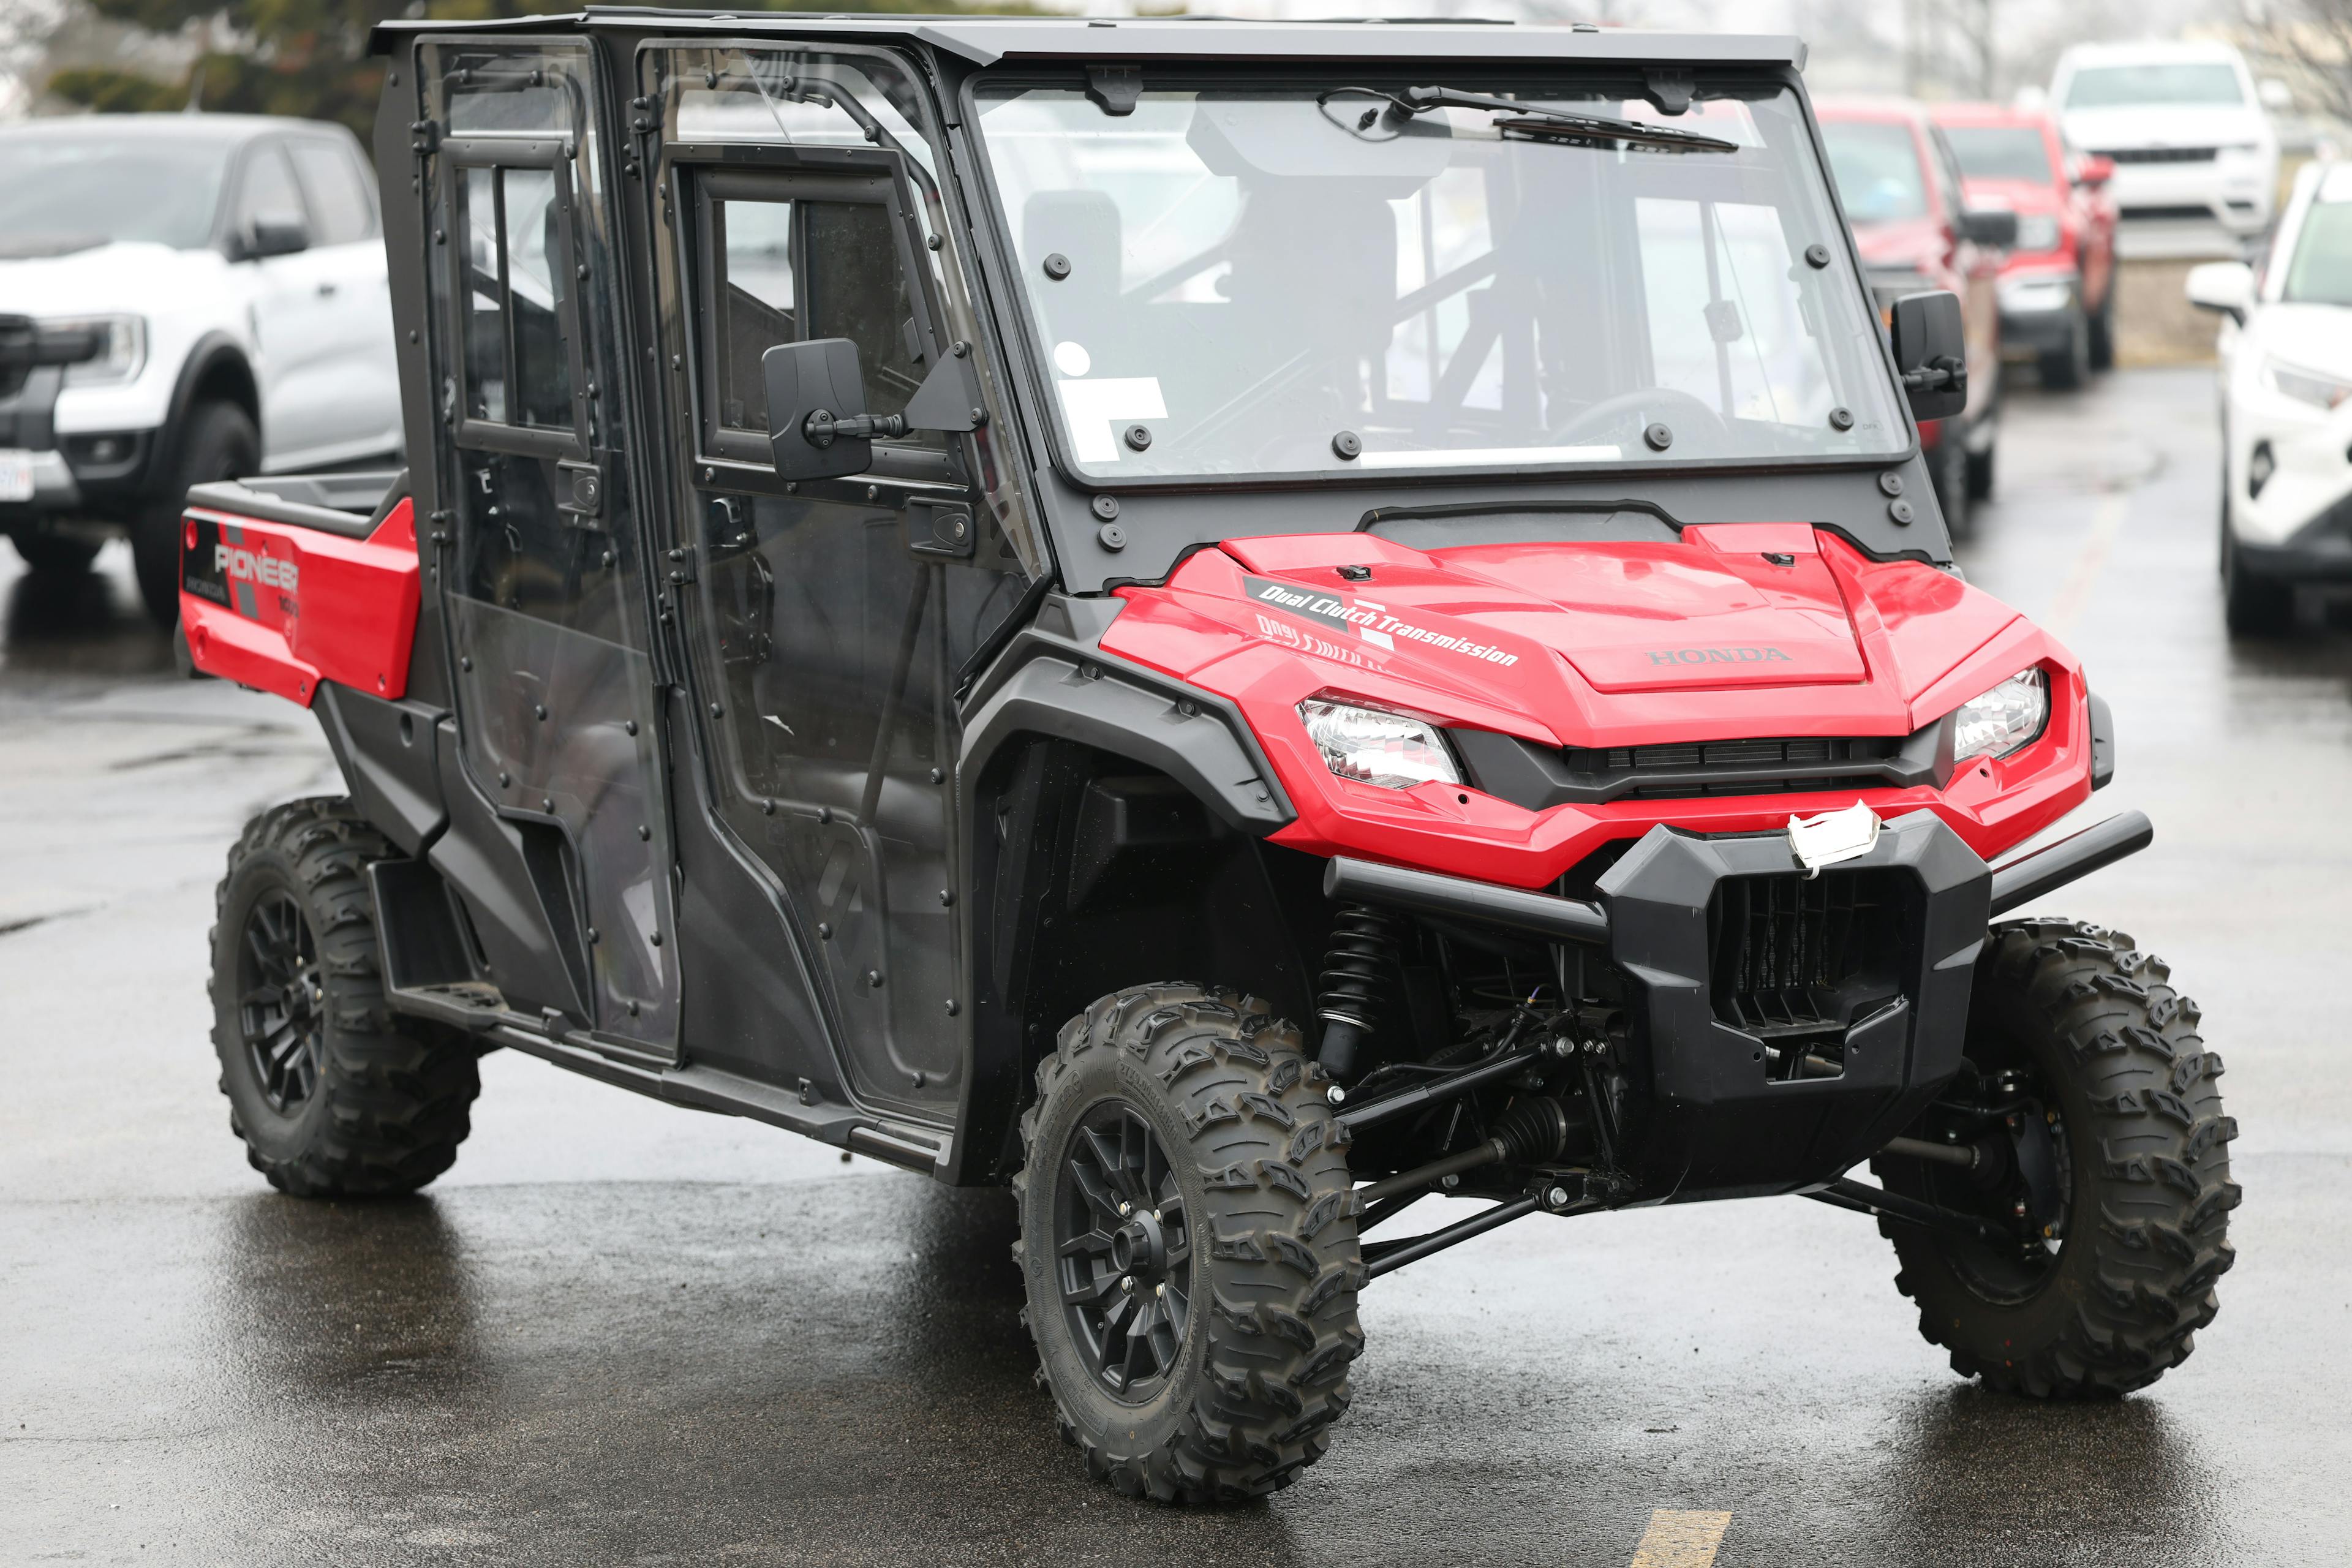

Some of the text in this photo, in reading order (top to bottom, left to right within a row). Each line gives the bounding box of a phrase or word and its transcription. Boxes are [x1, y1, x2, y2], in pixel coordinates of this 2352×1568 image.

[214, 543, 300, 595] PIONEER
[1258, 586, 1519, 666] Dual Clutch Transmission
[1646, 647, 1793, 666] HONDA
